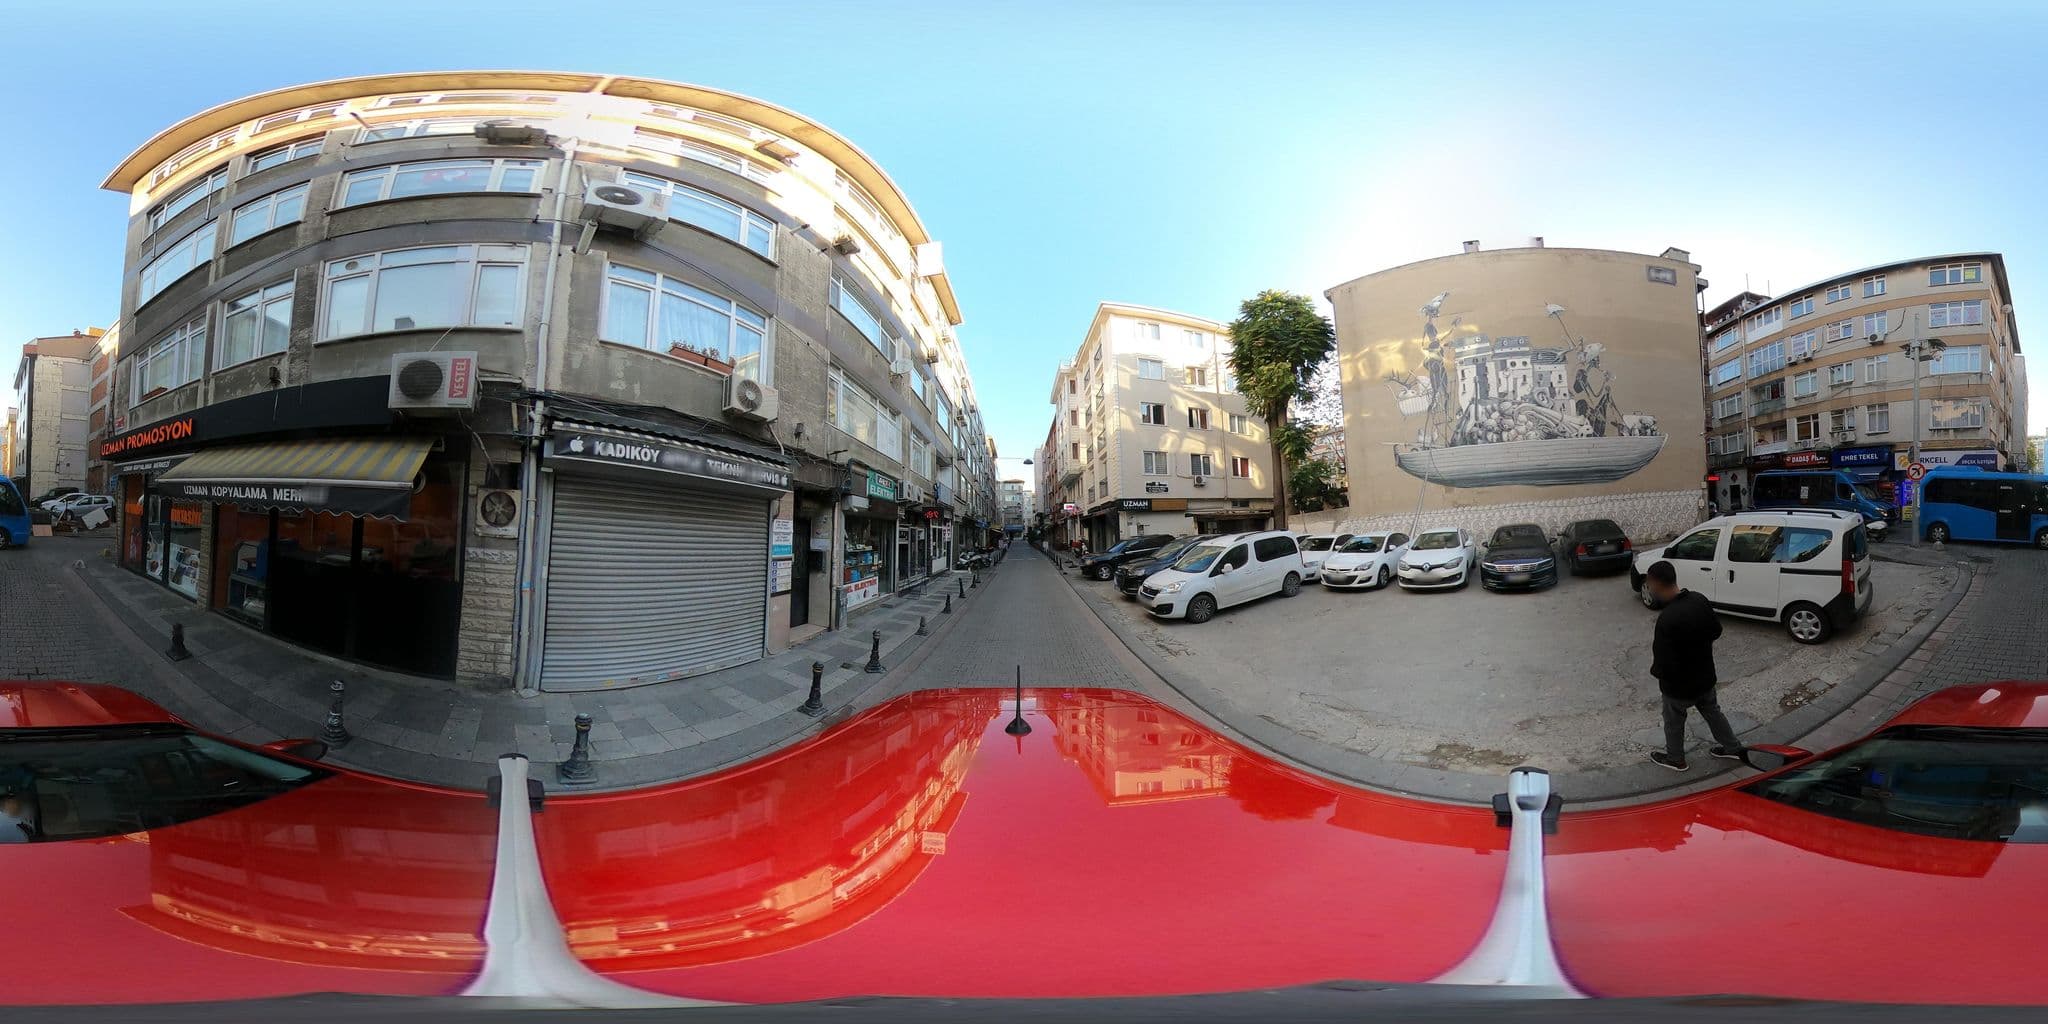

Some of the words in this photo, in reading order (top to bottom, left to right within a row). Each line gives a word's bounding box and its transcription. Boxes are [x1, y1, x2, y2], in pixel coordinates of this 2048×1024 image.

[453, 360, 467, 398] VESTEL
[101, 438, 126, 456] UZMAN
[127, 418, 193, 449] PROMOSYON
[594, 440, 660, 463] KADIKÖY
[1920, 456, 1949, 464] RKCELL
[183, 485, 208, 496] UZMAN
[211, 486, 267, 500] KOPYALAMA
